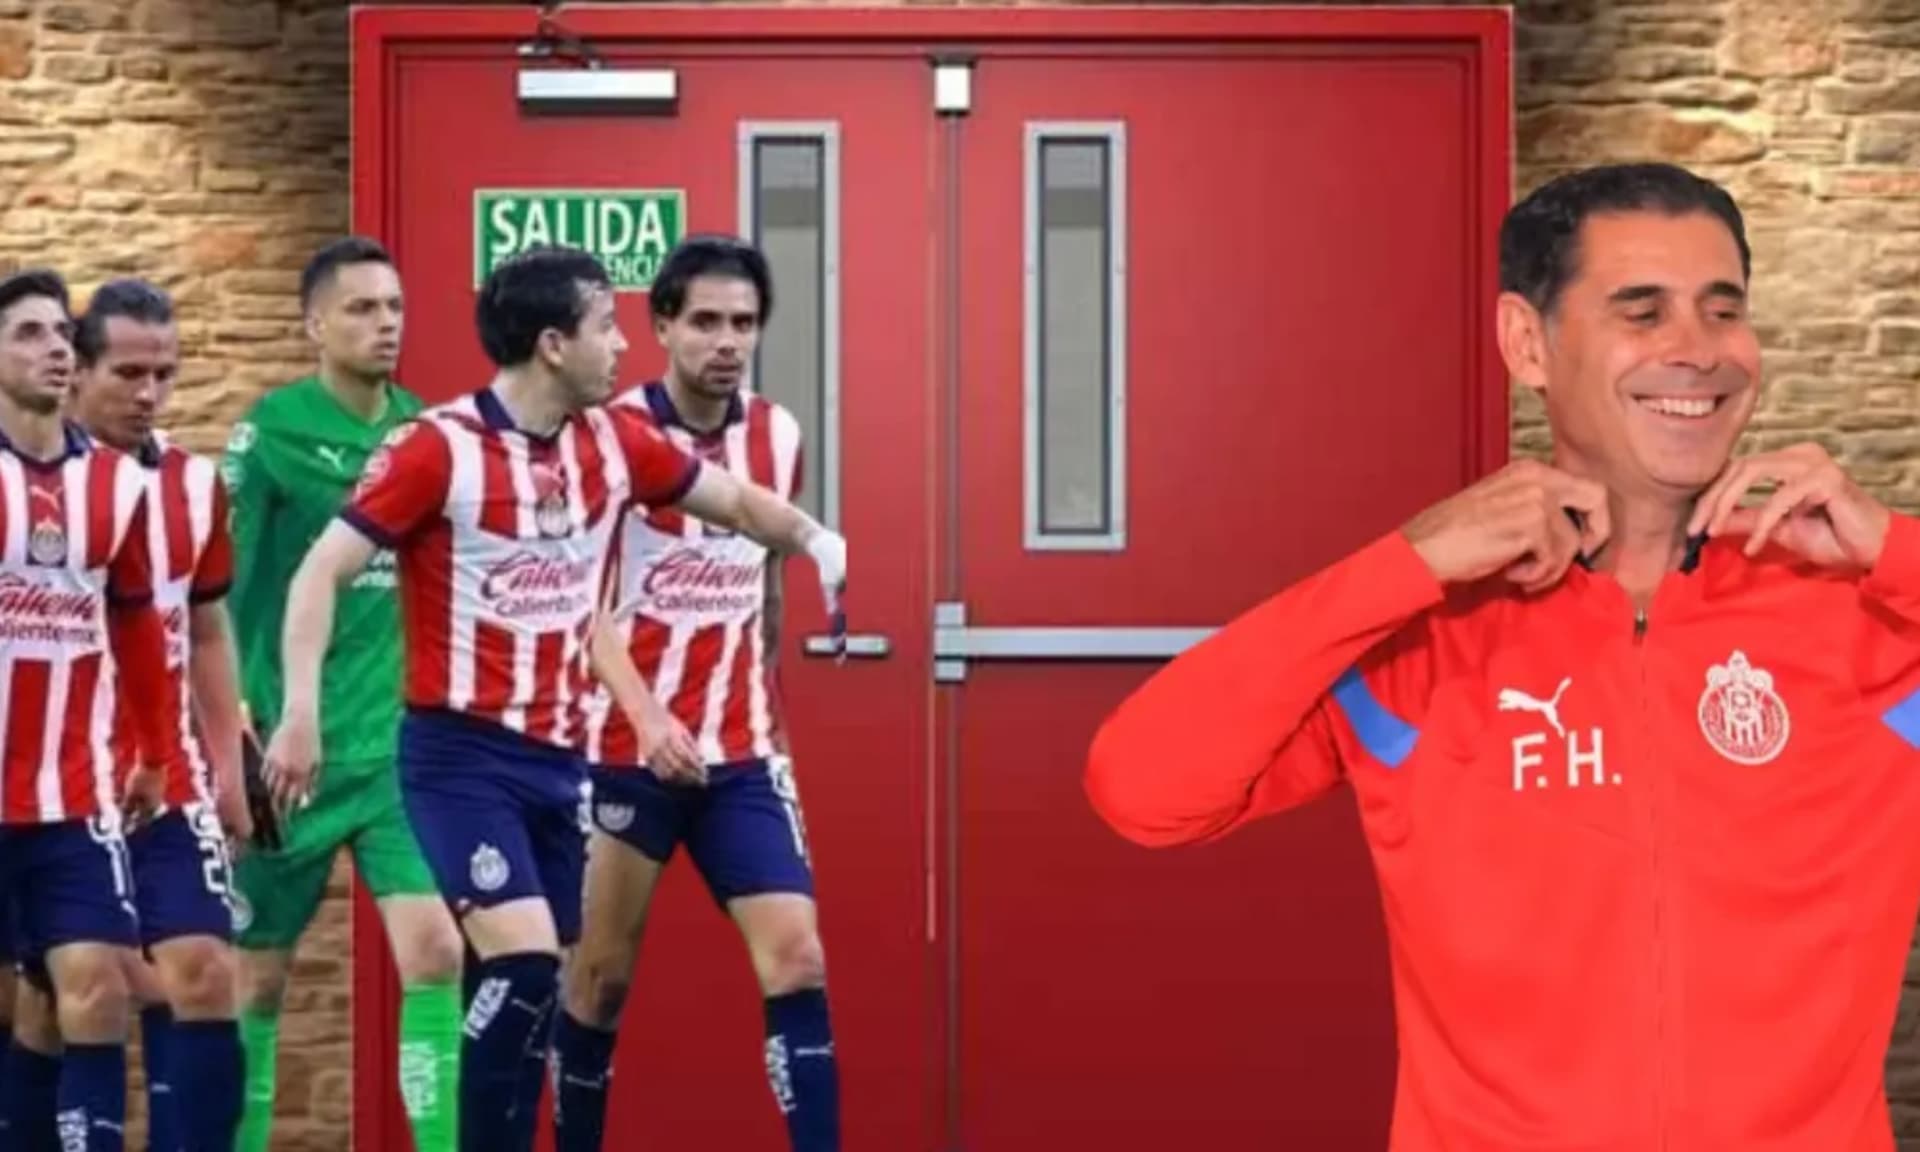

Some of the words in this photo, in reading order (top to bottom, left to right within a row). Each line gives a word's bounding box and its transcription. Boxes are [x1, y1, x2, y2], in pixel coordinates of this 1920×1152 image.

[490, 199, 667, 254] SALIDA
[1511, 732, 1548, 791] F.
[1566, 727, 1622, 787] H.
